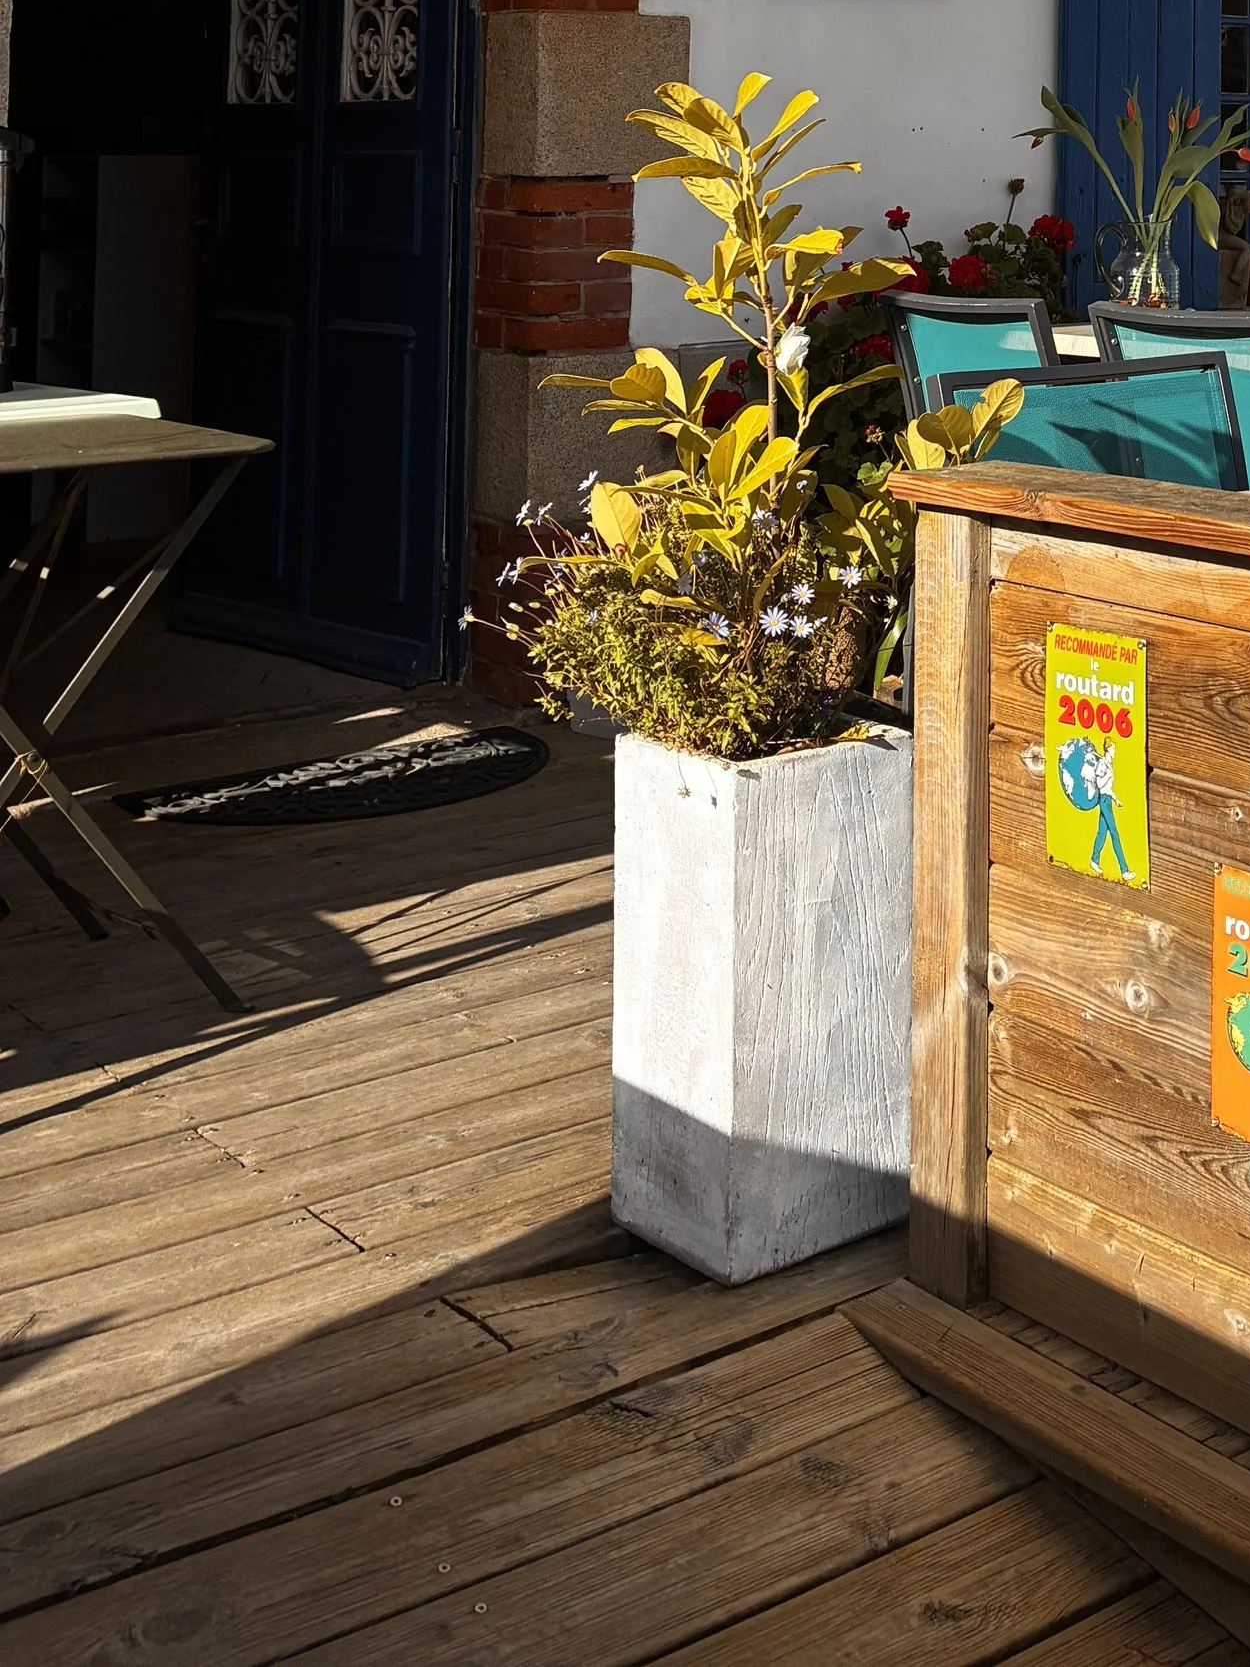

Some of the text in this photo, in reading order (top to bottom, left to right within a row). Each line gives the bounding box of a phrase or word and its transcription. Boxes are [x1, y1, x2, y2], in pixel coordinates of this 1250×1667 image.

[1054, 634, 1138, 665] RECOMMANDÉ PAR
[1090, 657, 1099, 672] le
[1056, 670, 1134, 705] routard
[1058, 695, 1133, 738] 2006
